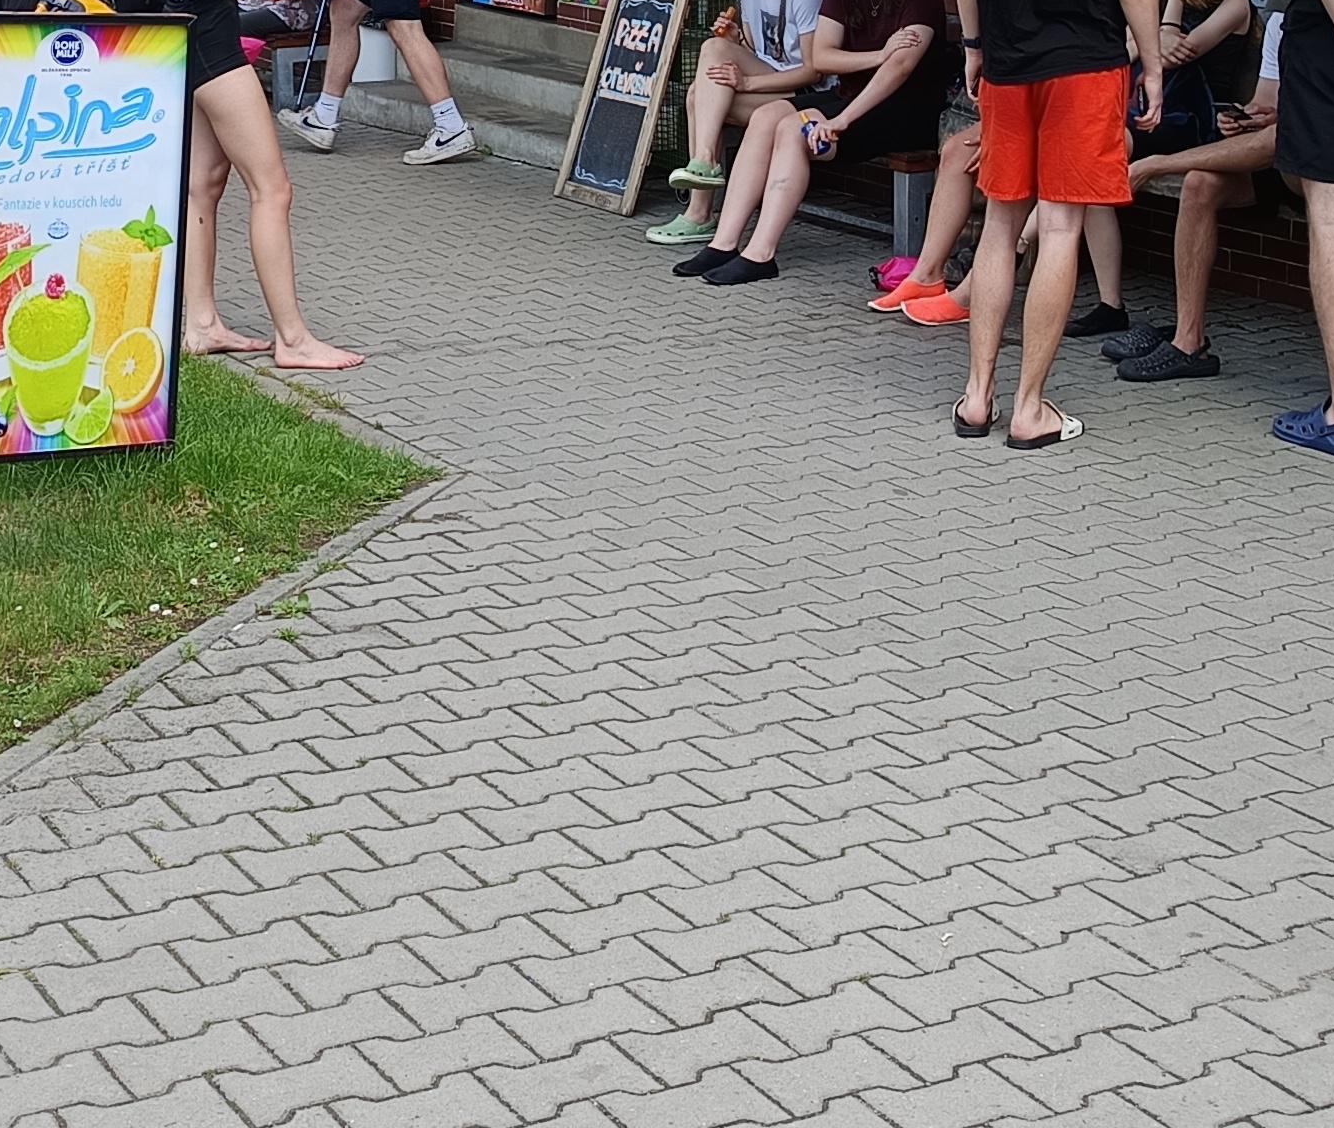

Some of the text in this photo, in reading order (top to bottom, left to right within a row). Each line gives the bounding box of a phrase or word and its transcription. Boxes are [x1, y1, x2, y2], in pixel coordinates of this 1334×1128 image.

[614, 17, 663, 55] PIZZA
[54, 40, 82, 50] BOHE
[55, 49, 79, 58] MILK
[74, 155, 133, 176] tříšť
[43, 200, 51, 209] v
[100, 194, 123, 208] ledu
